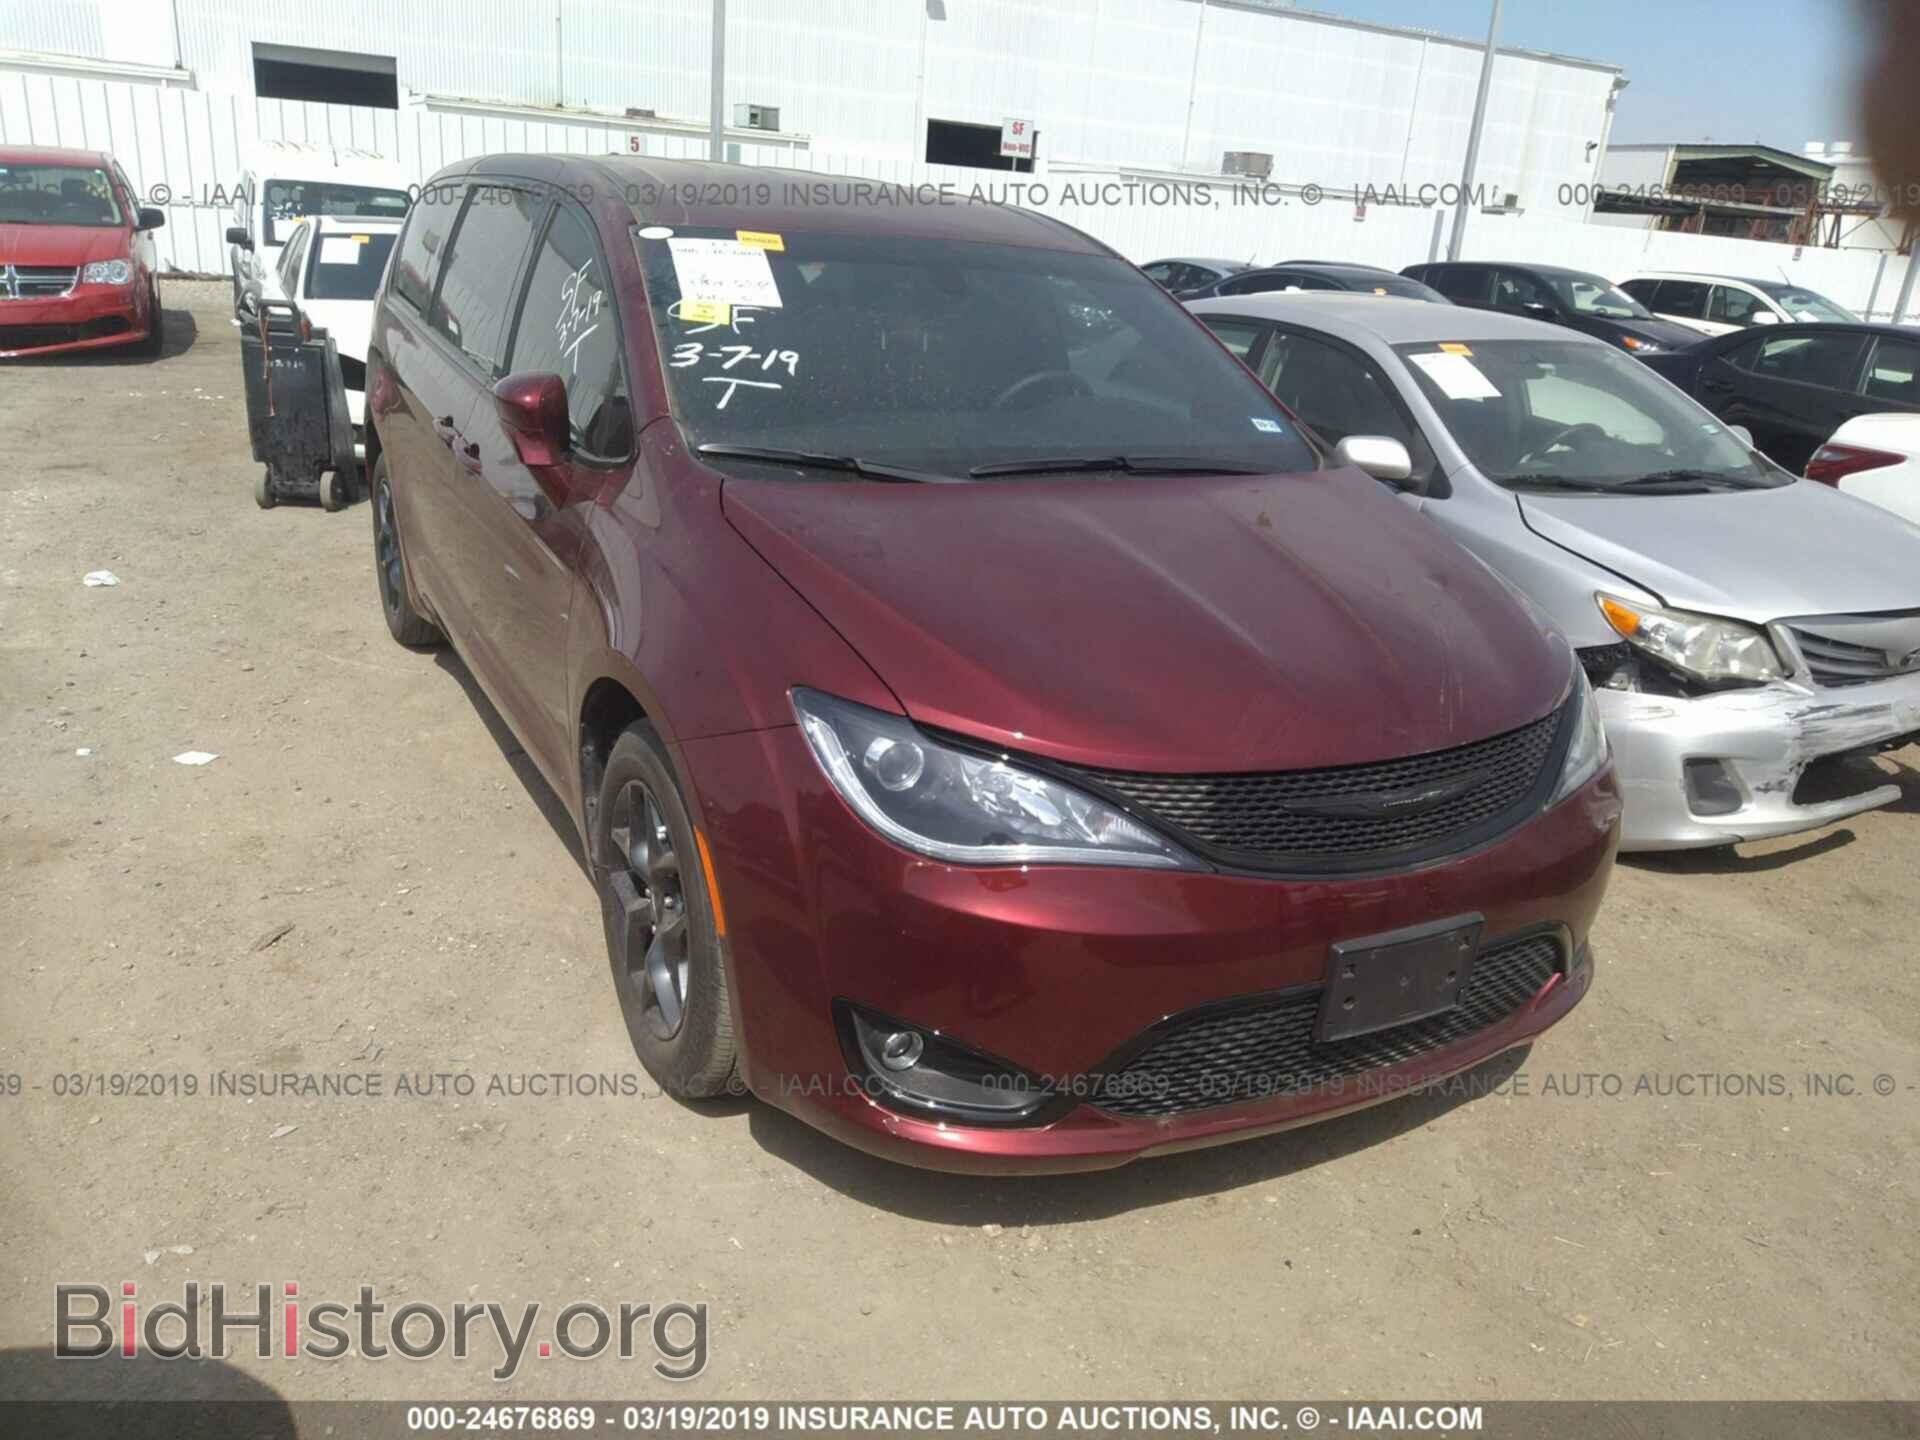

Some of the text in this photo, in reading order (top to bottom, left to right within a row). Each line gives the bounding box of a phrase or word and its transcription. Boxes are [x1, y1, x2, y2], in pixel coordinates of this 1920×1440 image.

[1012, 121, 1024, 135] SF
[630, 136, 640, 152] 5
[669, 343, 799, 376] 3-7-19
